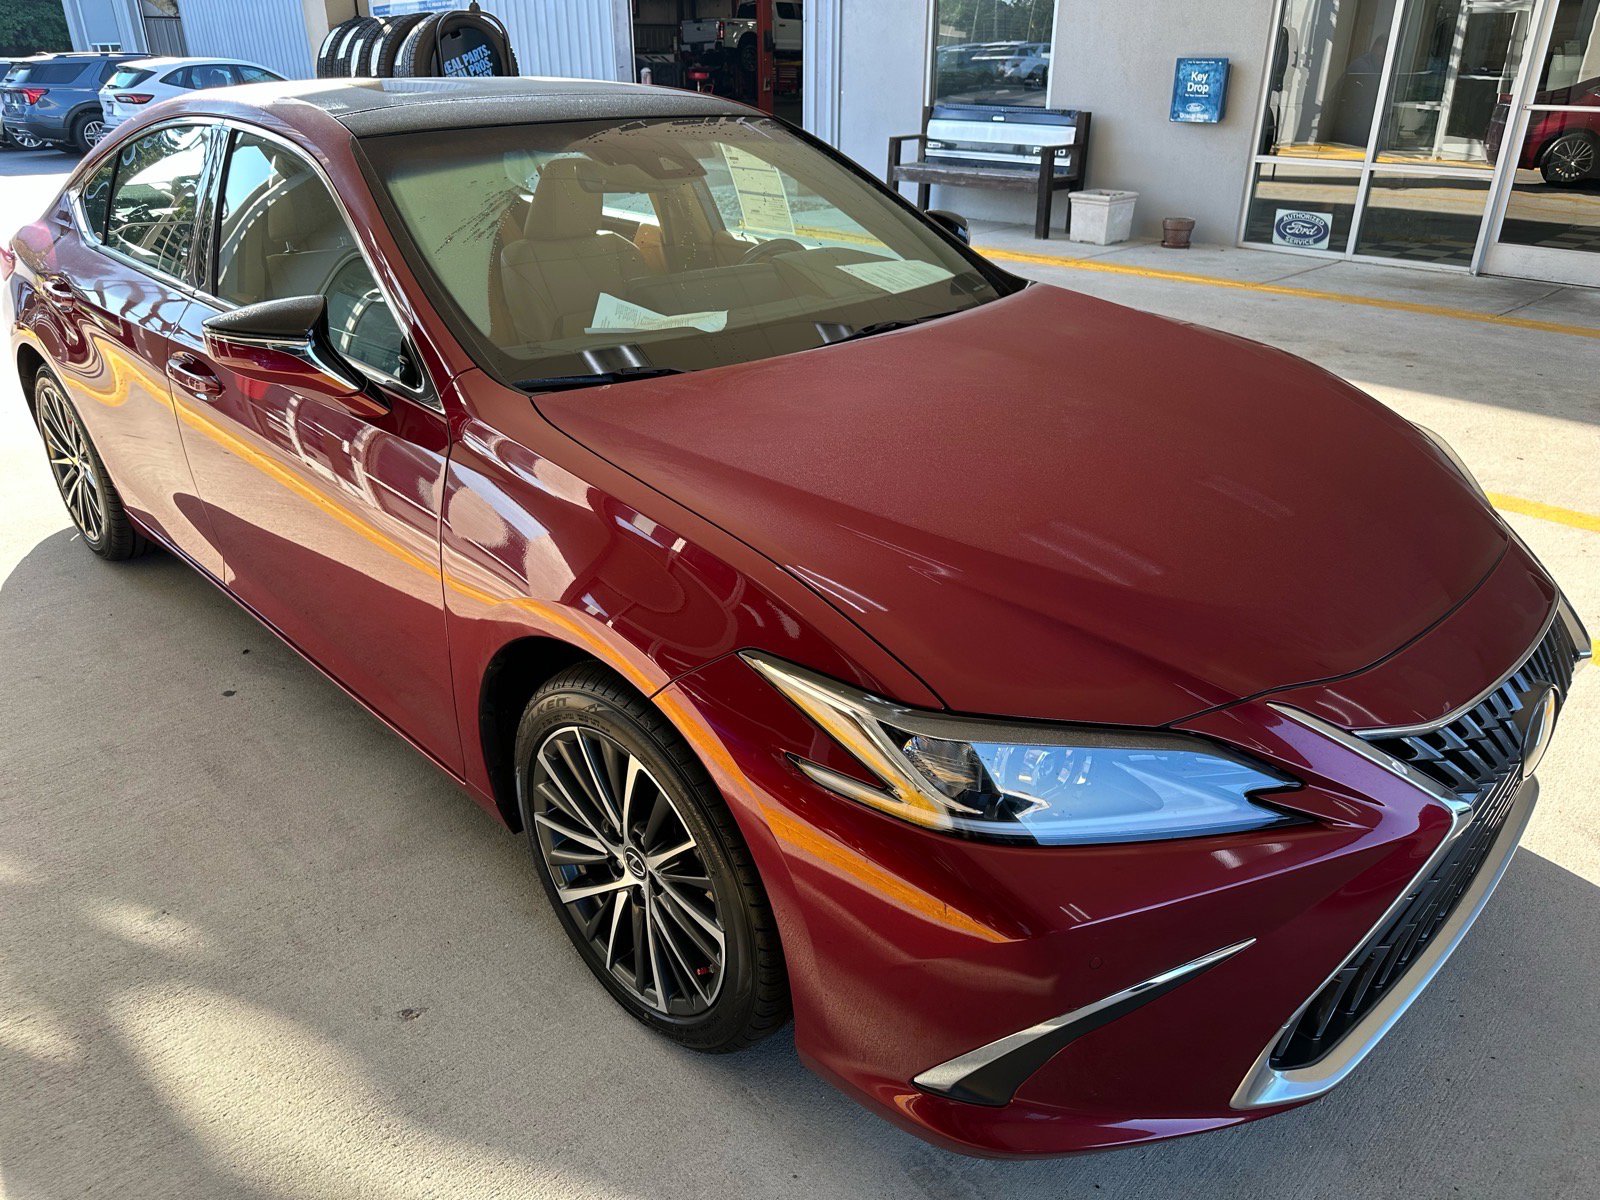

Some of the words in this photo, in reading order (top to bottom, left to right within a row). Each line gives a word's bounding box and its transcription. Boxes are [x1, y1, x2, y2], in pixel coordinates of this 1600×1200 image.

[462, 44, 491, 66] PARTS.
[468, 57, 493, 77] PROS.
[1191, 71, 1208, 84] Key
[1187, 82, 1209, 94] Drop
[1033, 146, 1066, 156] FD
[1283, 213, 1325, 226] AUTHORIZED
[1286, 221, 1318, 235] Ford
[1285, 235, 1314, 246] SERVICE
